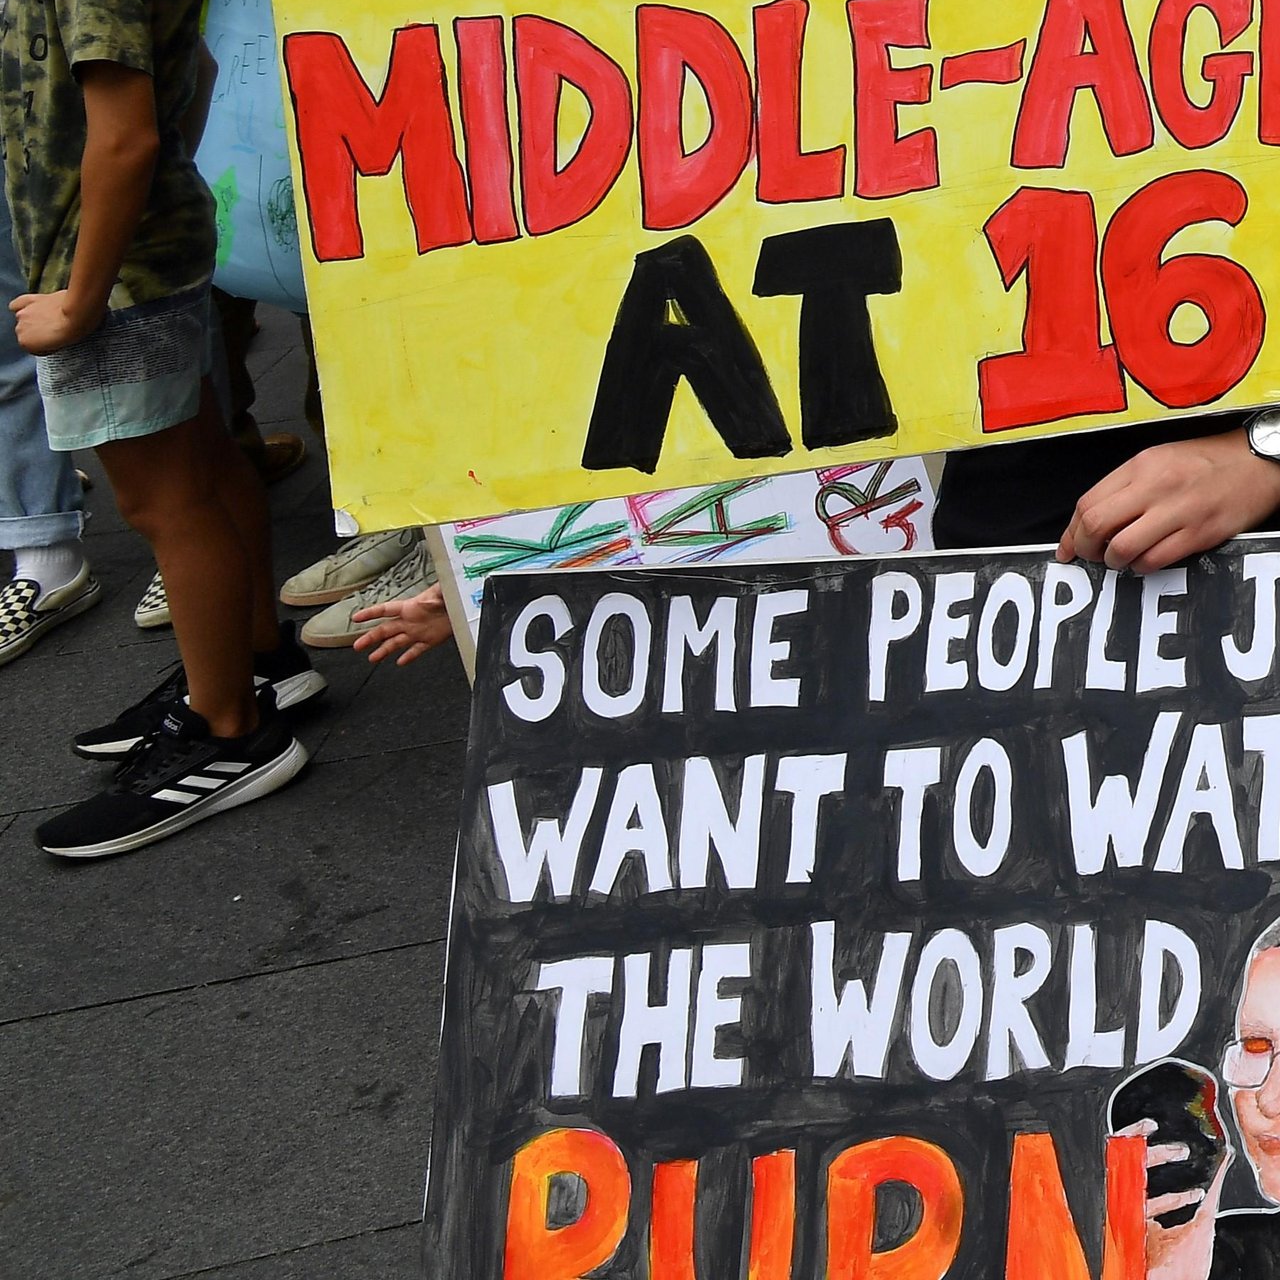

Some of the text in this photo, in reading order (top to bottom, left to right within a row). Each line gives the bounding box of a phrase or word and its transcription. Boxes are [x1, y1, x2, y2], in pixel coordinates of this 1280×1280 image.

[581, 171, 1266, 475] AT 16
[502, 589, 808, 722] SOME
[867, 564, 1188, 702] PEOPLE
[486, 753, 846, 903] WANT
[883, 737, 1013, 881] TO
[535, 920, 1202, 1097] THE WORLD
